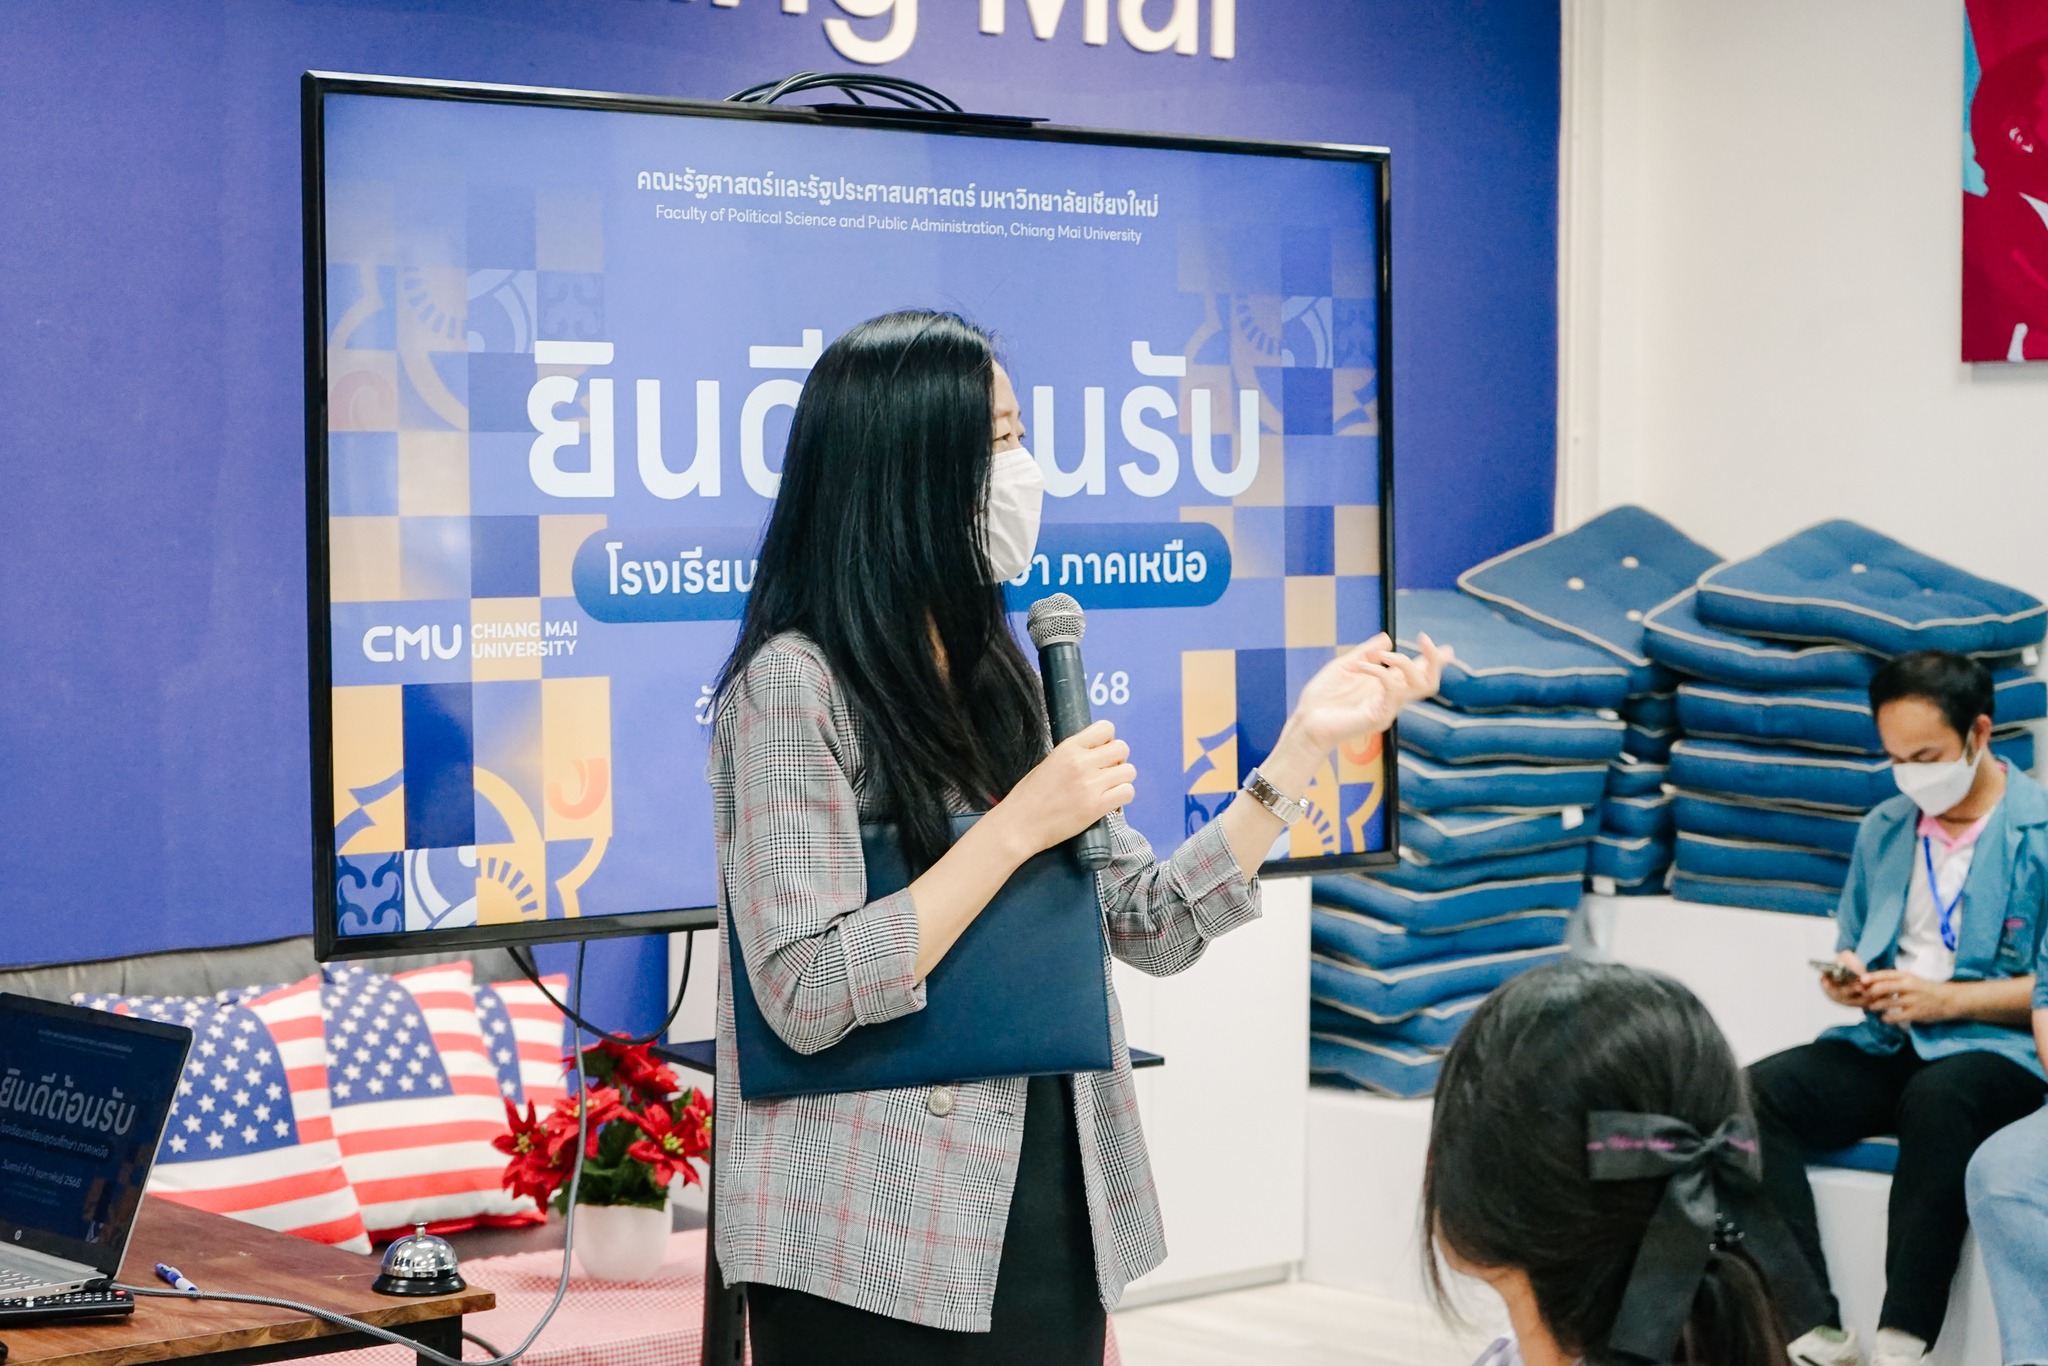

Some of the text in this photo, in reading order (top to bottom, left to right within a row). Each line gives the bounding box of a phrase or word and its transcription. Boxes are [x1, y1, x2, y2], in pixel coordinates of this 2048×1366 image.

[637, 167, 1159, 217] คณะรัฐศาสตร์และรัฐประศาสนศาสตร์ มหาวิทยาลัยเชียงใหม่
[656, 204, 1142, 245] Faculty of Political Science and Public Administration, Chiang Mai University
[1058, 538, 1208, 586] ภาคเหนือ
[362, 623, 463, 663] CMU
[471, 620, 578, 640] CHIANG MAI
[471, 639, 578, 659] UNIVERSITY
[1085, 670, 1130, 706] 68
[0, 1067, 136, 1136] ยินดีต้อนรับ
